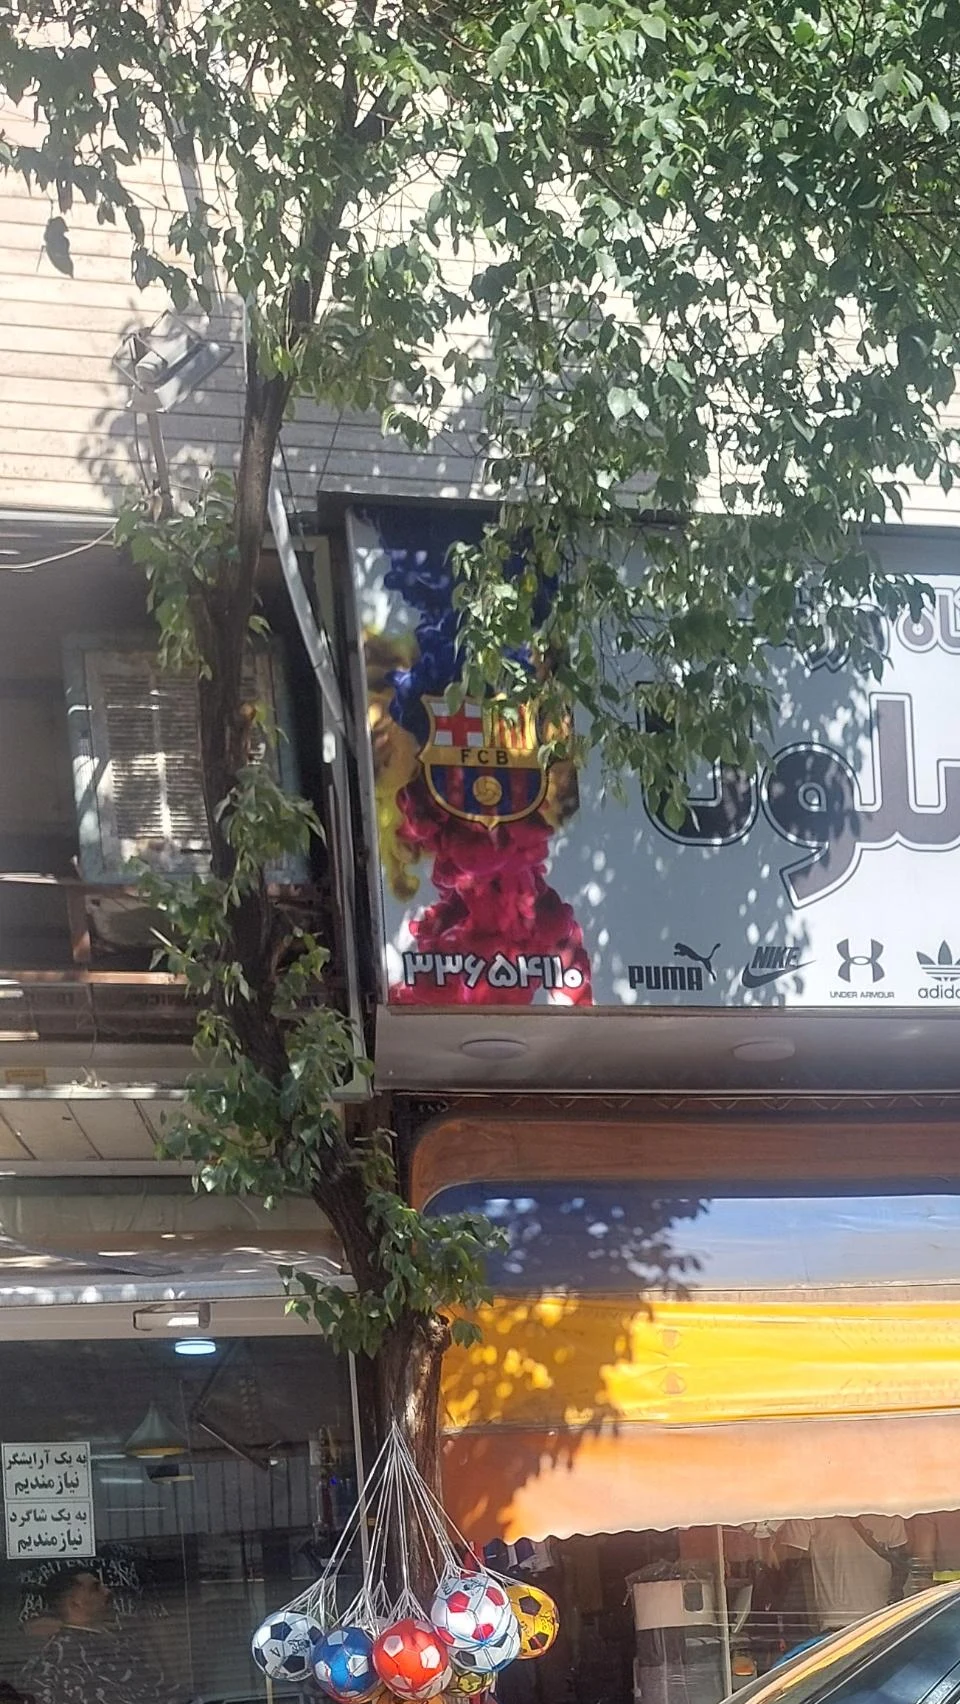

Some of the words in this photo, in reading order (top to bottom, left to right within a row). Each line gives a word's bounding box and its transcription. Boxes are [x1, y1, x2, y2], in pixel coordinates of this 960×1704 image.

[461, 749, 509, 765] FCB
[751, 946, 800, 969] NIKE
[402, 951, 584, 989] ۳۳۶۵۴۱۱۰
[628, 965, 703, 991] PUMA
[829, 991, 858, 999] UNDER
[860, 991, 895, 999] ARMOUR
[6, 1449, 51, 1470] آرایشگر
[54, 1451, 73, 1468] یک
[76, 1453, 86, 1468] به
[15, 1471, 80, 1495] نیازمندیم
[10, 1508, 47, 1527] شاگرد
[51, 1508, 71, 1525] یک
[75, 1511, 87, 1525] به
[18, 1528, 83, 1553] نیازمندیم
